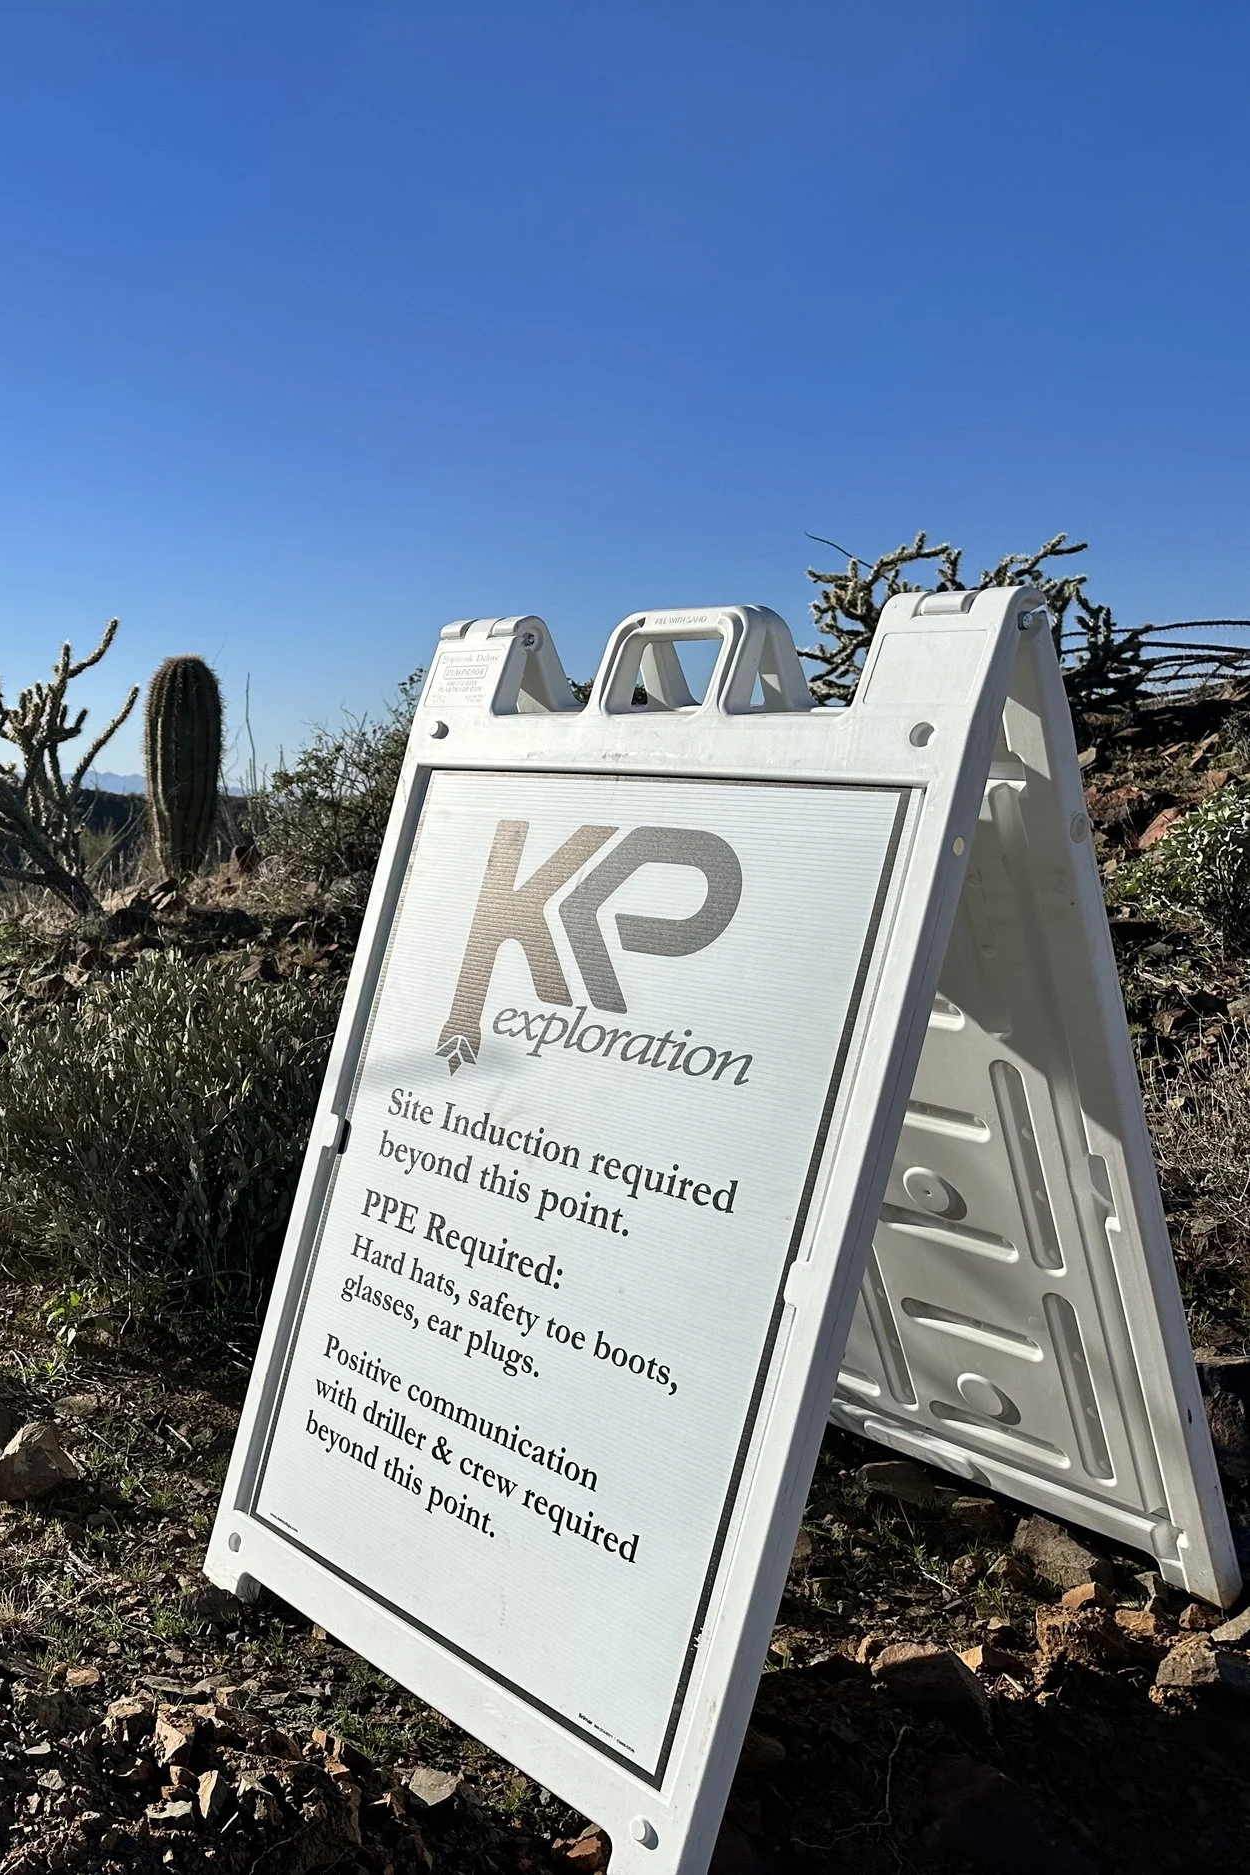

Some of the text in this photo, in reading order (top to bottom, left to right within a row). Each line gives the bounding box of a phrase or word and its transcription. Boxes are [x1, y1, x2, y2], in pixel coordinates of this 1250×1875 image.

[492, 1005, 753, 1086] exploration
[378, 1129, 630, 1238] beyond this point.
[387, 1087, 739, 1214] Site Induction required
[360, 1188, 564, 1290] PPE Required:
[340, 1274, 541, 1379] glasses, ear plugs.
[350, 1232, 678, 1396] Hard hats, safety toe boots,
[305, 1409, 496, 1539] beyond this point.
[315, 1377, 640, 1564] with driller & crew required
[322, 1332, 598, 1493] Positive communication
